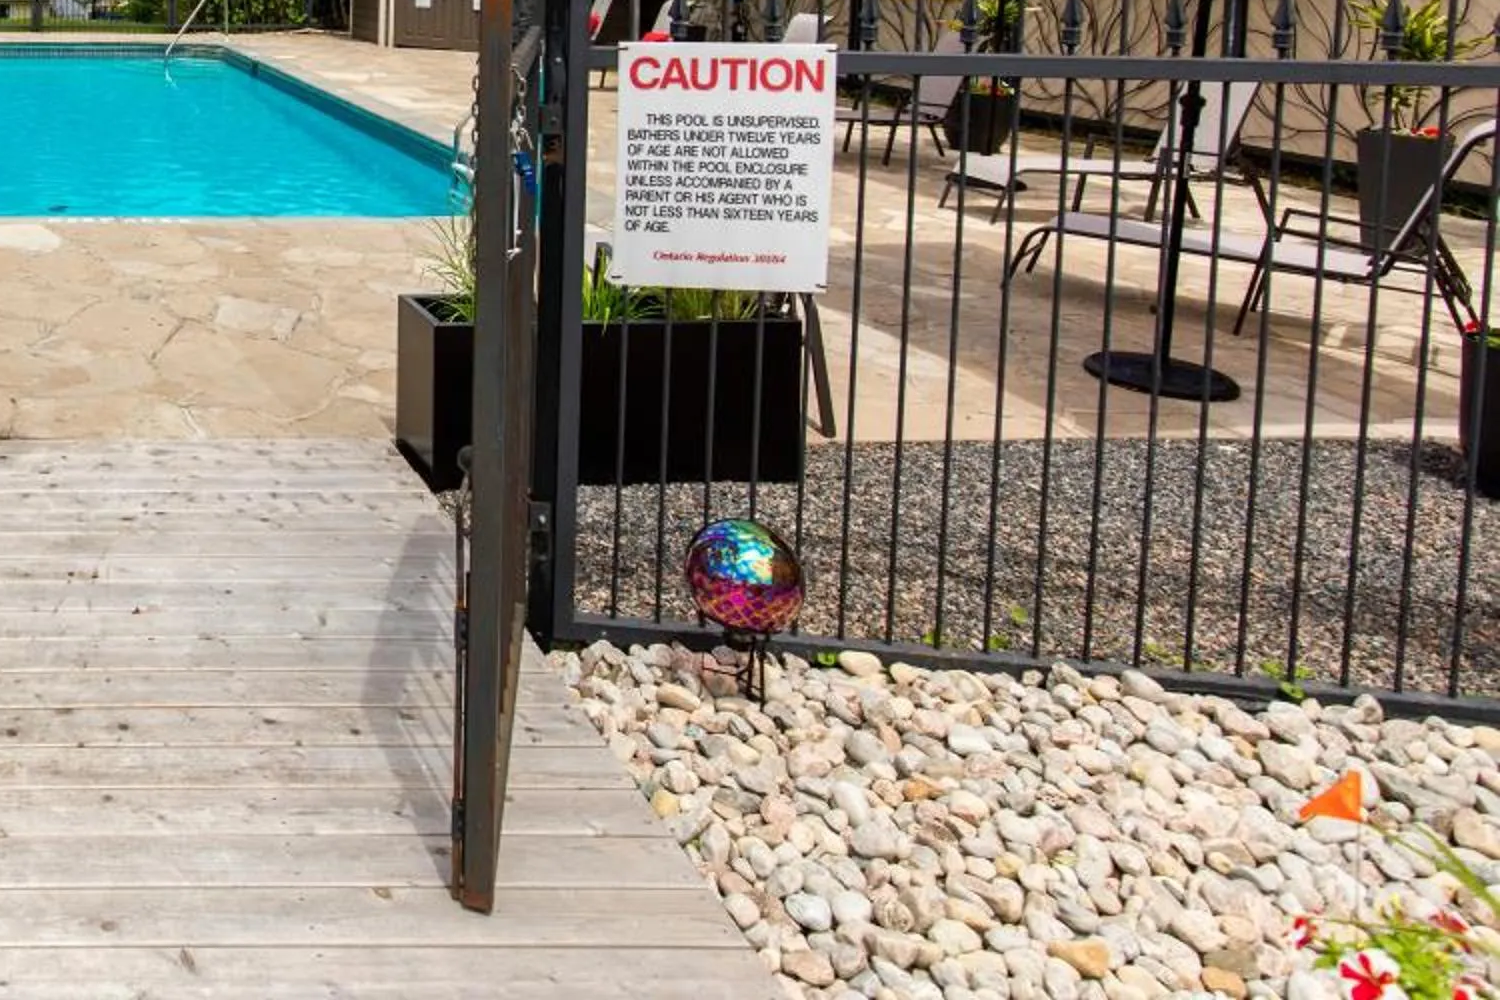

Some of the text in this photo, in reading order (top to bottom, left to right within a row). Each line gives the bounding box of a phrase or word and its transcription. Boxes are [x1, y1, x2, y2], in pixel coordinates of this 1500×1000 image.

[630, 56, 825, 92] CAUTION
[647, 114, 820, 129] THIS POOL IS UNSUPERVISED.
[628, 130, 820, 145] BATHERS UNDER TWELVE YEARS
[628, 144, 789, 159] OF AGE ARE NOT ALLOWED
[628, 160, 808, 176] WITHIN THE POOL ENCLOSURE
[627, 175, 793, 190] UNLESS ACCOMPANIED BY A
[626, 190, 807, 207] PARENT OR HIS AGENT WHO IS
[625, 206, 819, 222] NOT LESS THAN SIXTEEN YEARS
[625, 220, 671, 233] OF AGE.
